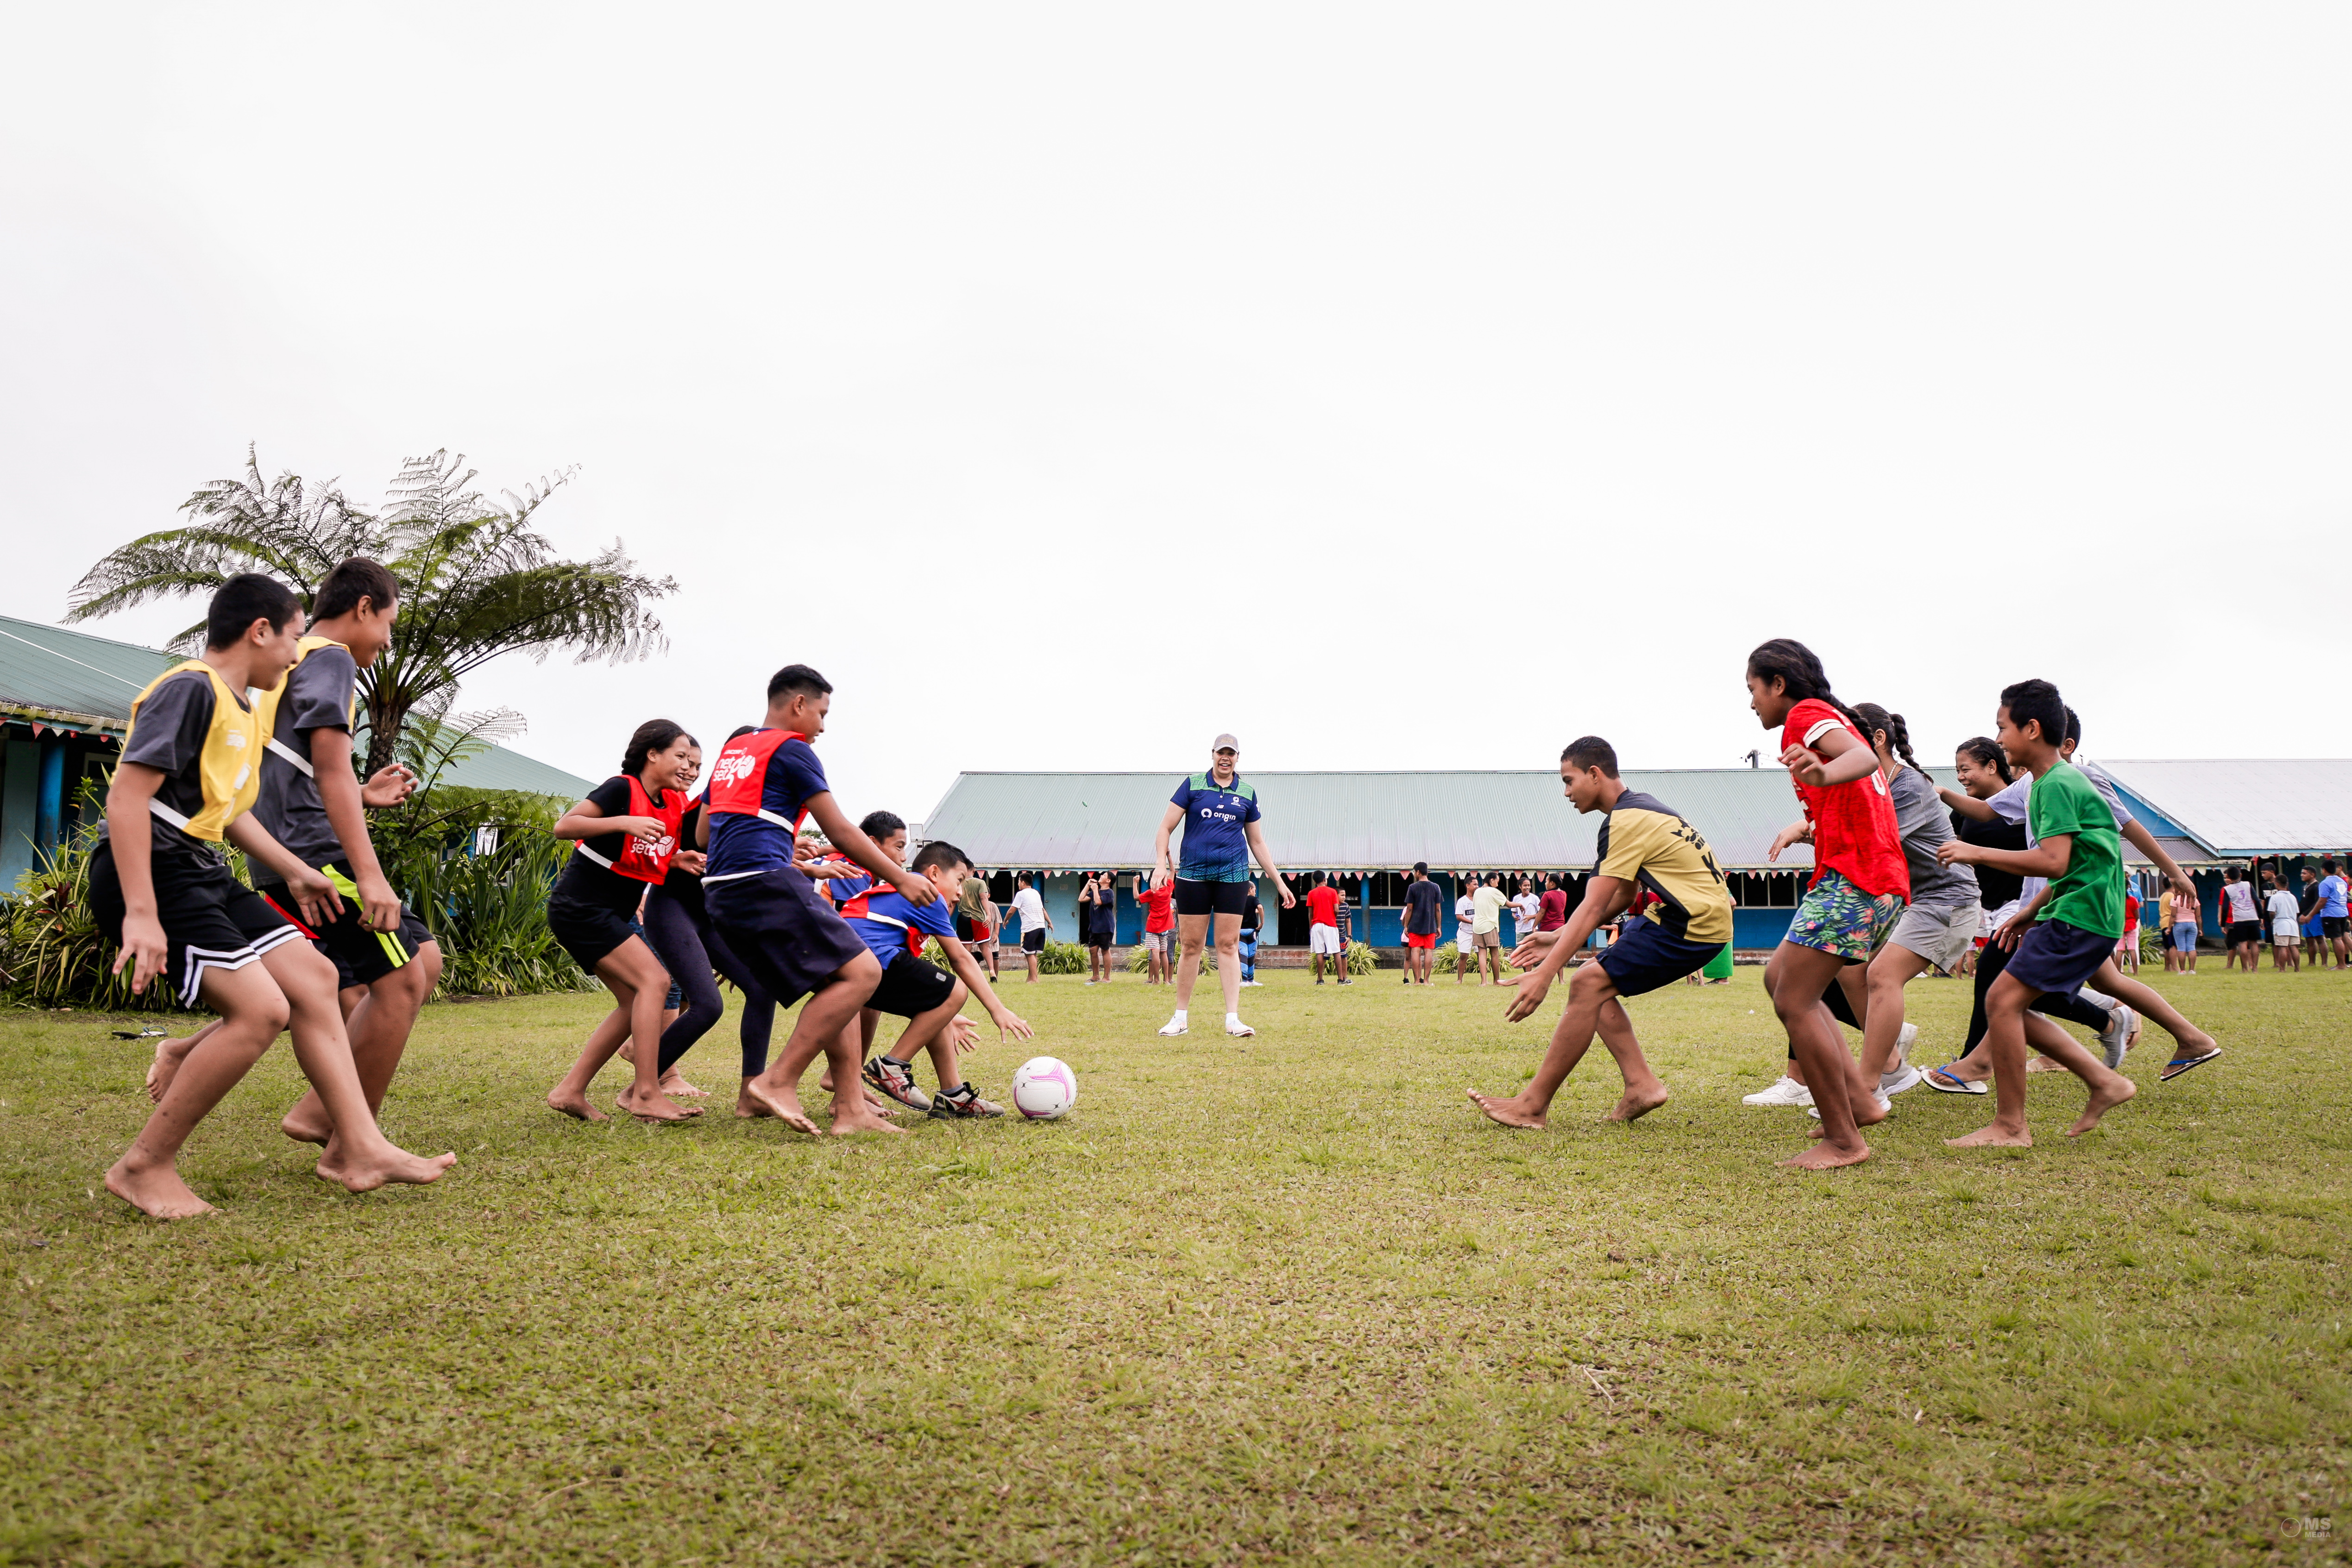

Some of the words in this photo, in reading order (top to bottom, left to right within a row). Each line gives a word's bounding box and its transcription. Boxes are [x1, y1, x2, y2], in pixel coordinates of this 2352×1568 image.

[713, 767, 730, 781] set
[1214, 812, 1236, 822] origin
[2238, 890, 2245, 900] 3
